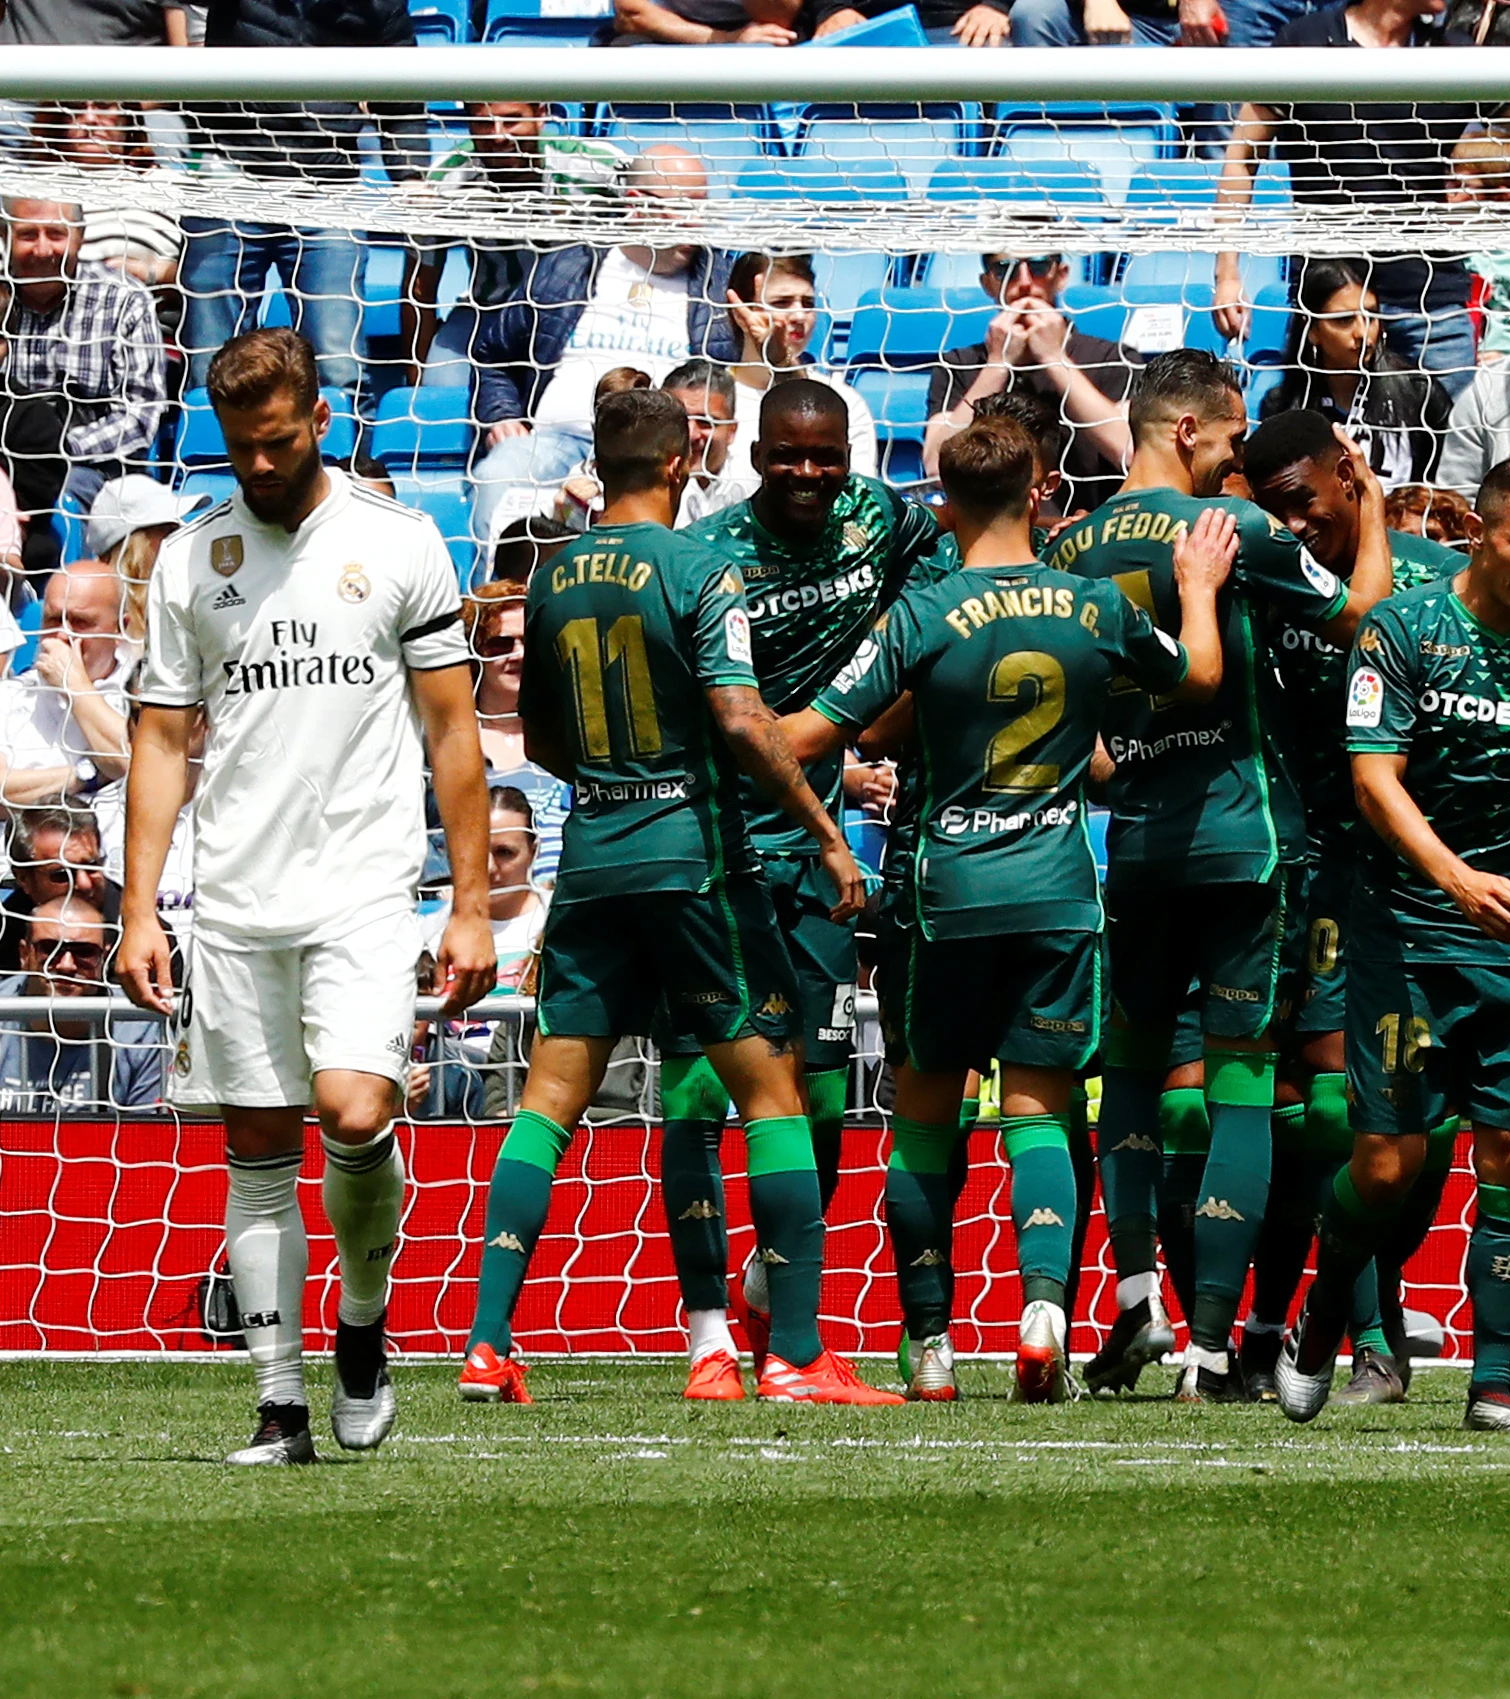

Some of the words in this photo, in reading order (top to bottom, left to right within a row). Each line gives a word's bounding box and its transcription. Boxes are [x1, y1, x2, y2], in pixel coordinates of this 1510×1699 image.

[551, 552, 653, 595] C.TELLO
[212, 597, 247, 610] adidas
[944, 587, 1075, 640] FRANCIS
[271, 619, 318, 648] Fly
[223, 650, 376, 696] Emirates
[553, 615, 662, 763] 11
[982, 650, 1066, 795] 2
[1031, 1016, 1085, 1032] Kappa
[1375, 1012, 1432, 1074] 18
